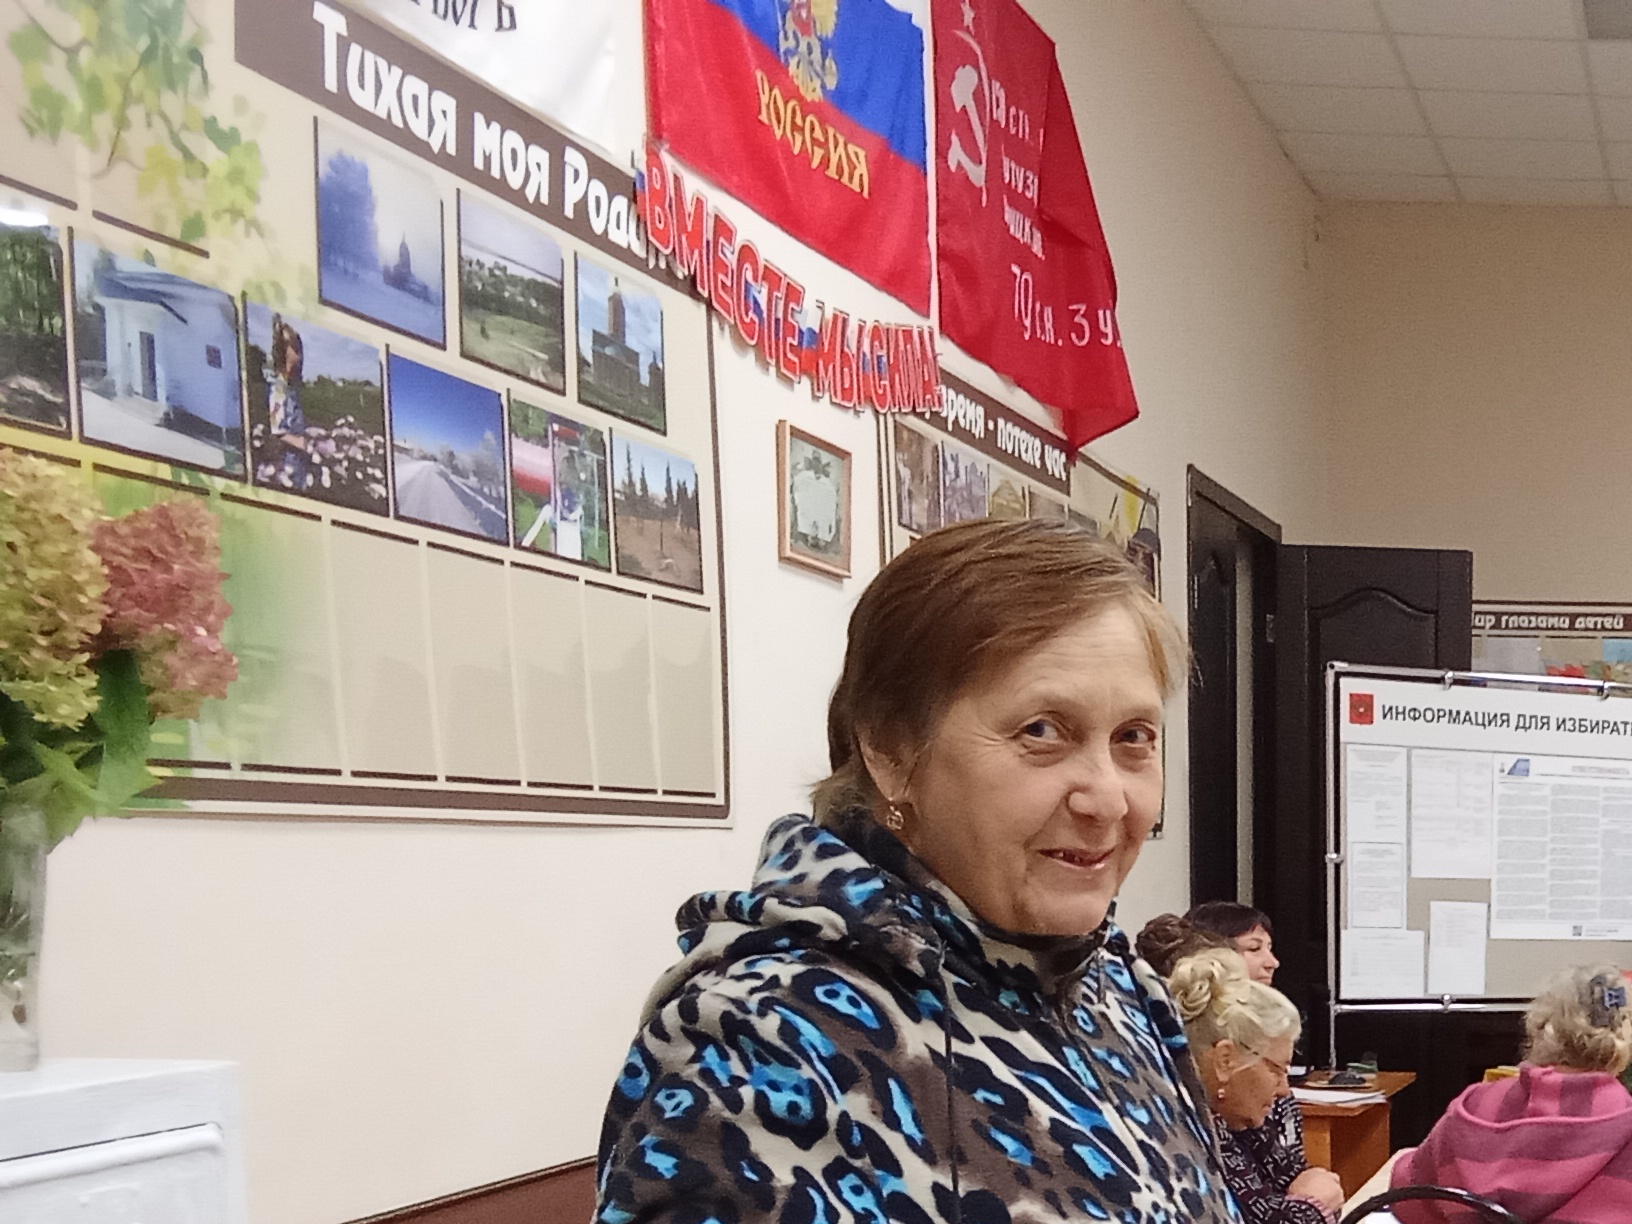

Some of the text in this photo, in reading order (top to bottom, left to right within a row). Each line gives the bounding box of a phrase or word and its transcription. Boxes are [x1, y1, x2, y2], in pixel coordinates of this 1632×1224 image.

[312, 9, 457, 156] Тихая
[473, 110, 551, 206] моя
[755, 68, 872, 200] РОССИЯ
[645, 142, 806, 384] ВМЕСТЕ
[814, 300, 867, 413] МЫ
[1068, 303, 1091, 347] 3
[997, 417, 1042, 470] потехе
[1043, 444, 1067, 482] час
[1474, 613, 1625, 631] ир глазами детей
[1381, 703, 1511, 730] ИНФОРМАЦИЯ
[1515, 711, 1551, 733] ДЛЯ
